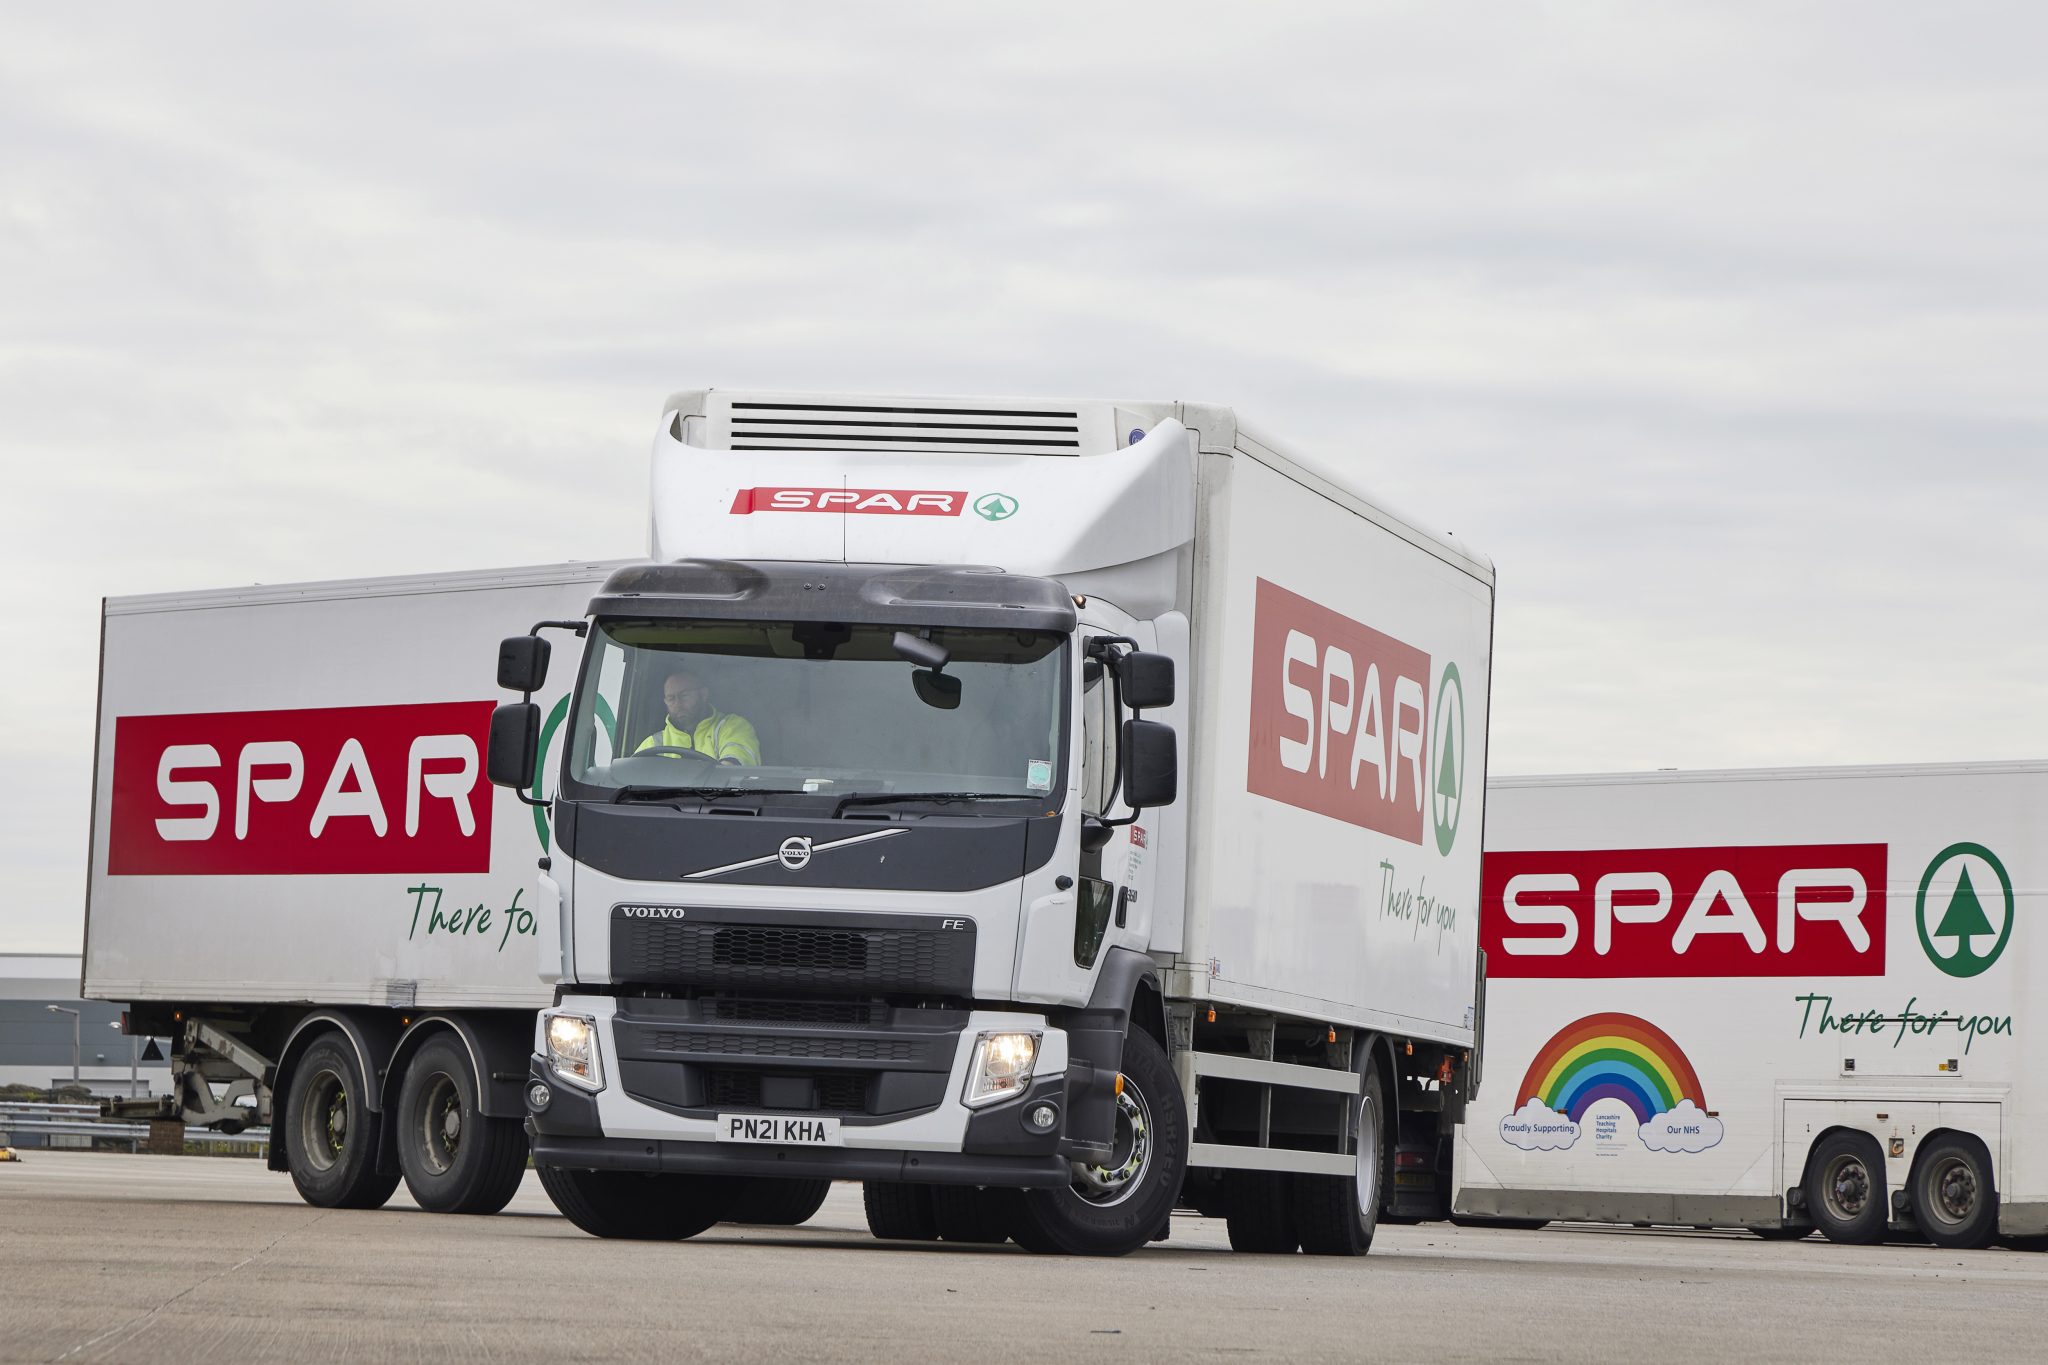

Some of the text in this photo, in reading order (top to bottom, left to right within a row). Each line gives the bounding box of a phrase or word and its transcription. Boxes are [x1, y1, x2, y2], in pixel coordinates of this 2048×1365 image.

[770, 490, 953, 513] SPAR
[1279, 628, 1425, 812] SPAR
[154, 733, 480, 842] SPAR
[781, 849, 810, 858] VOLVO
[407, 883, 492, 941] There
[621, 906, 685, 920] VOLVO
[1379, 858, 1456, 957] There for you
[1502, 867, 1872, 957] SPAR
[941, 919, 966, 931] FE
[1795, 992, 2013, 1056] There for you
[730, 1118, 826, 1142] PN21 KHA
[1503, 1123, 1575, 1135] Proudly Supporting
[1667, 1125, 1700, 1135] Our NHS
